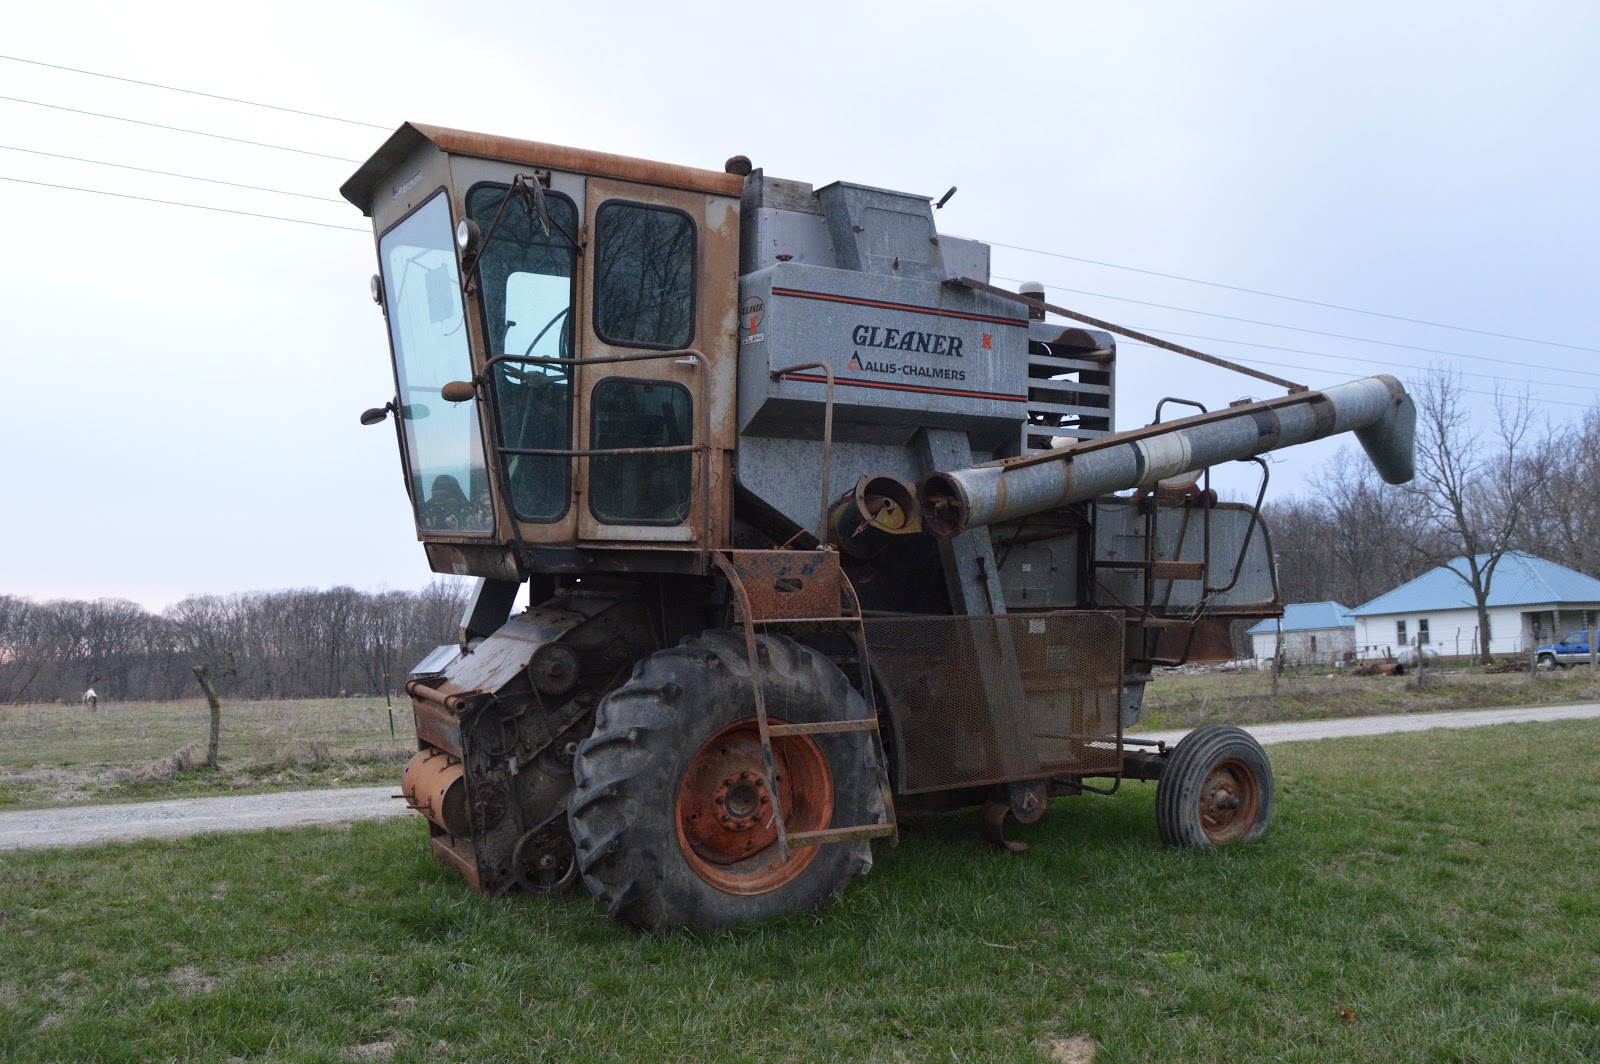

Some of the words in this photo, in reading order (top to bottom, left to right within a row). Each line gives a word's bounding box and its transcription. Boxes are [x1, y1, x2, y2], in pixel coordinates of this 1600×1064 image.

[740, 304, 763, 315] LEANER
[852, 324, 963, 357] GLEANER
[981, 332, 993, 350] K
[864, 361, 966, 381] ALLIS-CHALMERS
